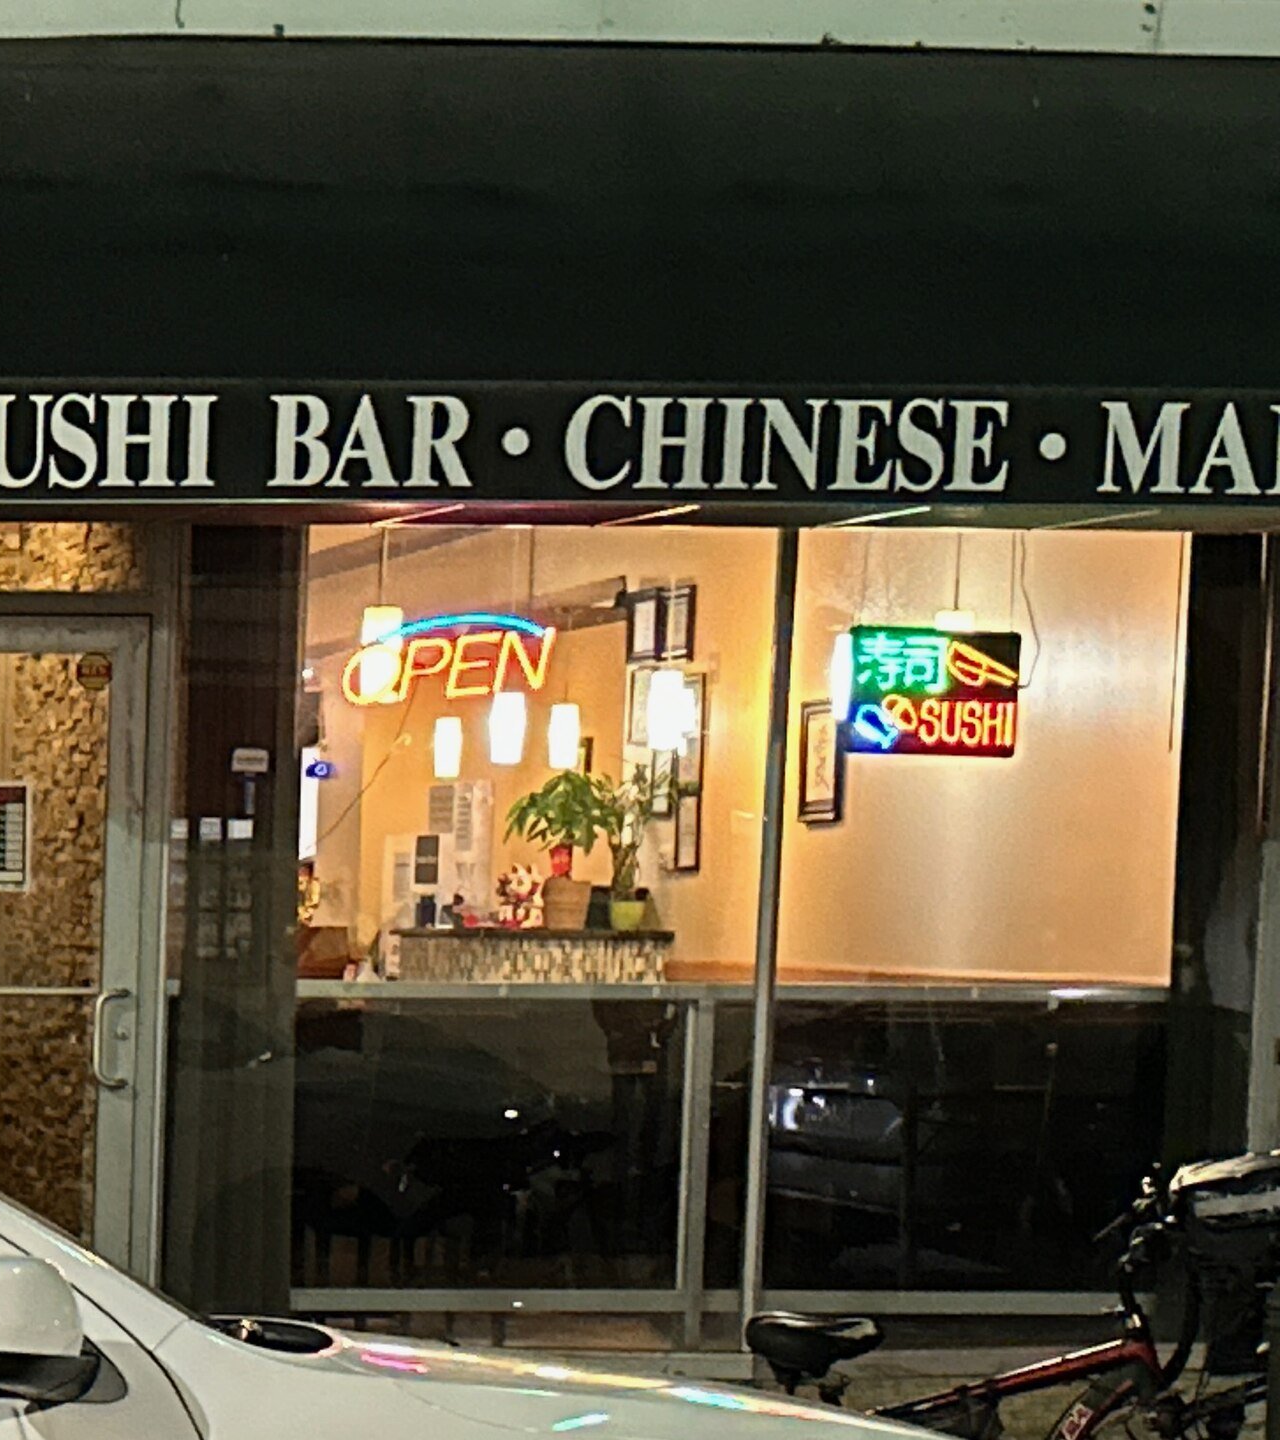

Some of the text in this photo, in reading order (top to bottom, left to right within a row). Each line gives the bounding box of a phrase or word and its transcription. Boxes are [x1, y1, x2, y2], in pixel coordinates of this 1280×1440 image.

[267, 393, 472, 488] BAR
[564, 394, 1008, 492] CHINESE
[1096, 401, 1280, 495] MA
[342, 626, 556, 706] OPEN
[857, 632, 948, 693] 寿司
[918, 698, 1016, 748] SUSHI
